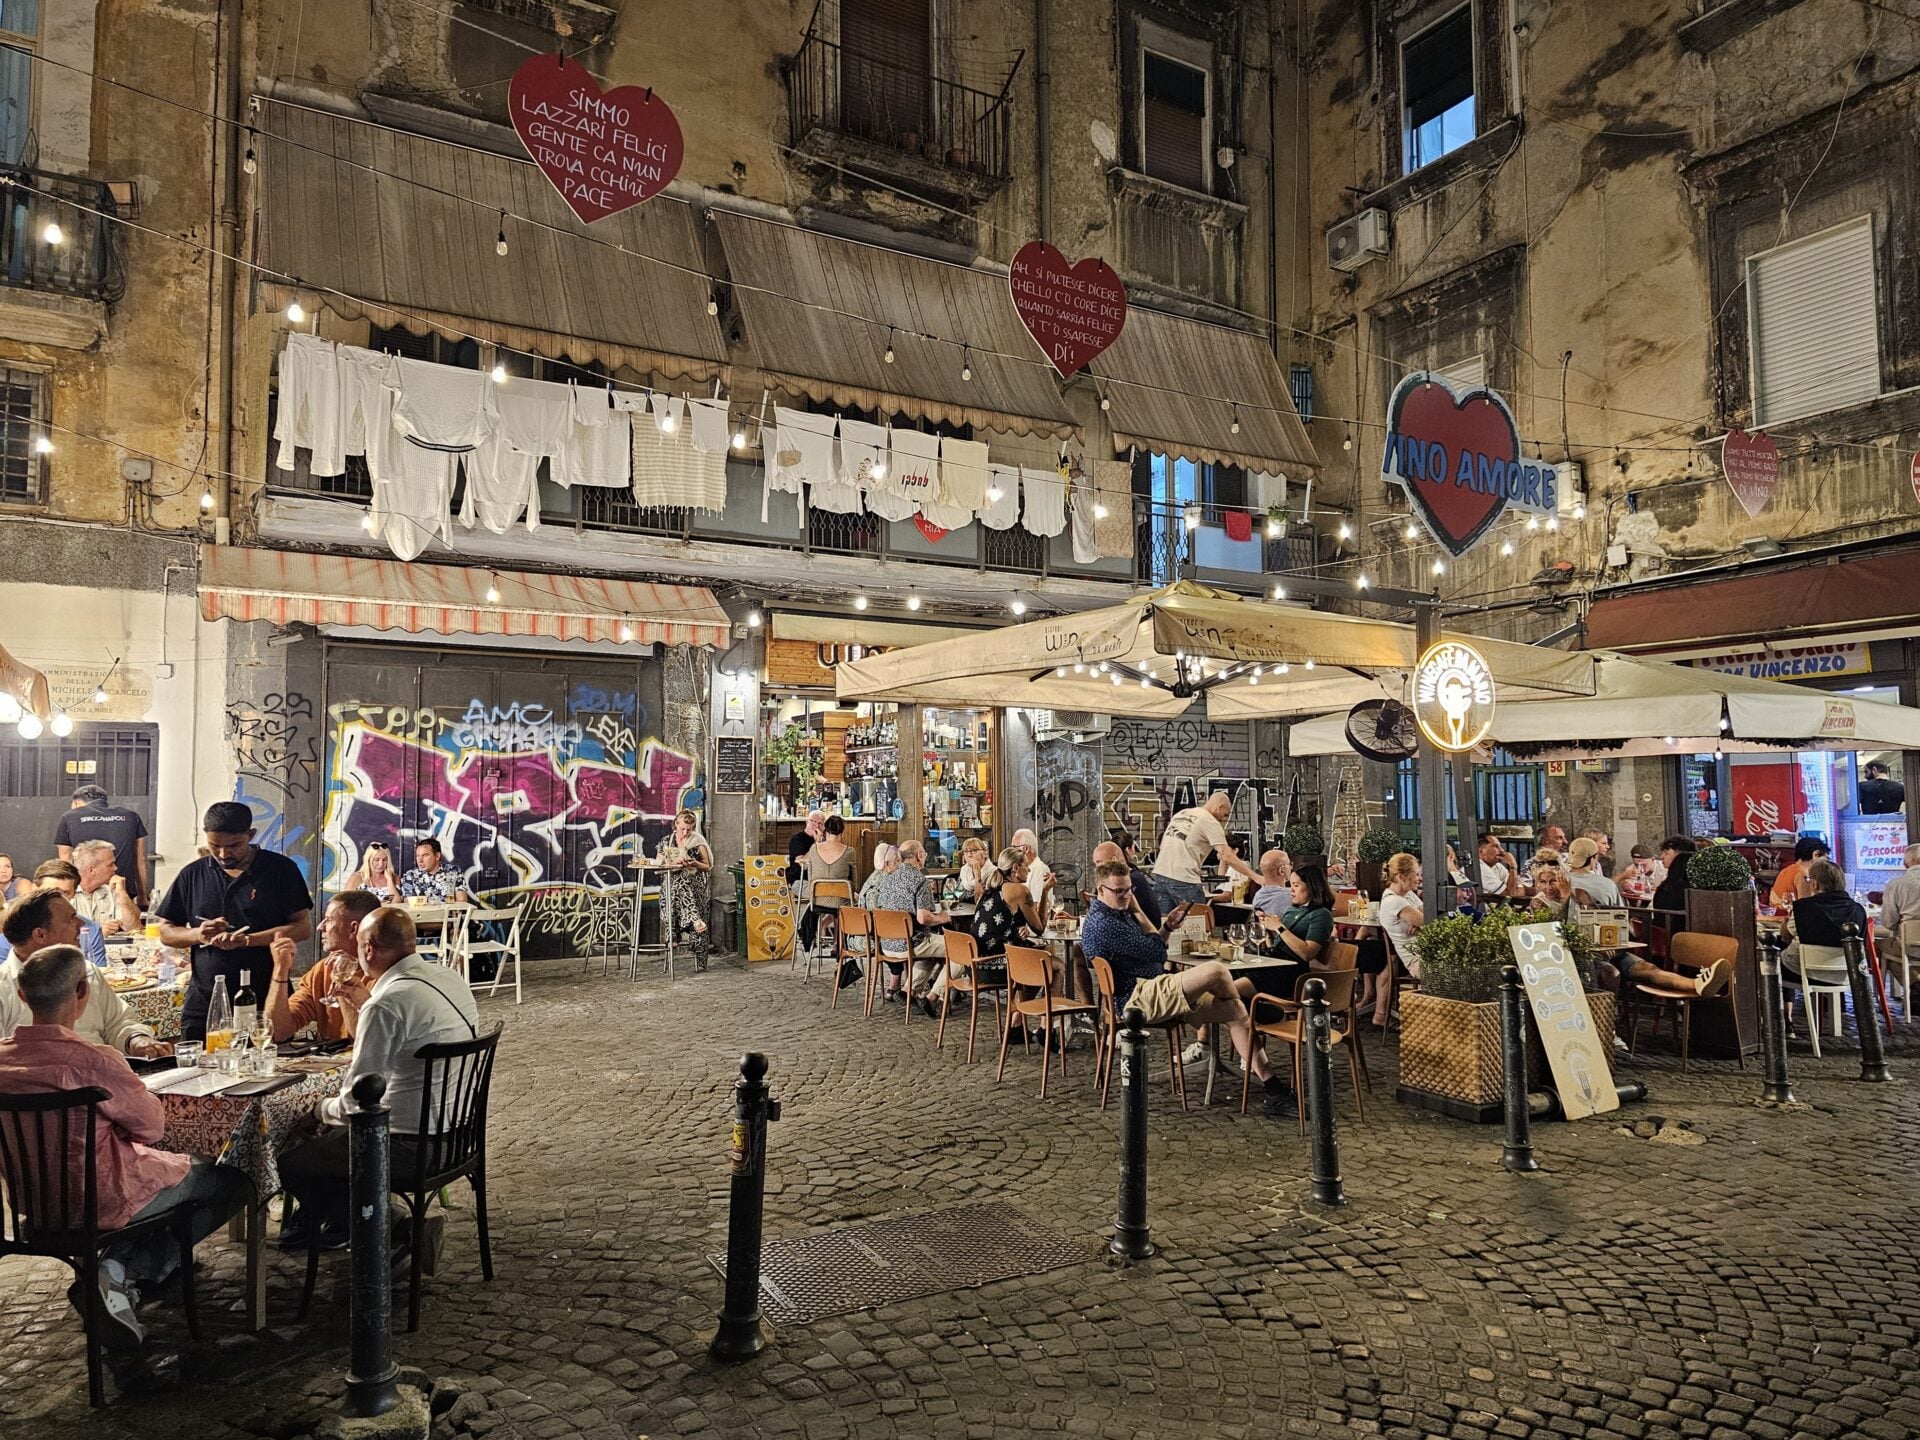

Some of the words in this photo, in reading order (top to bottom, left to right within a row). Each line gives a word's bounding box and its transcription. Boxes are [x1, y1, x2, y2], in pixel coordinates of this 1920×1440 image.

[568, 88, 630, 127] SIMMO
[522, 93, 606, 140] LAZZARI
[613, 128, 667, 162] FELICI
[528, 122, 589, 155] GENTE
[593, 145, 616, 165] CA
[623, 156, 661, 182] NUN
[533, 144, 584, 176] TROVA
[563, 177, 614, 210] PACE
[1012, 278, 1052, 299] CHELLO
[1074, 296, 1098, 313] CORE
[1101, 303, 1121, 320] DICE
[1088, 283, 1119, 302] DICERE
[1087, 317, 1115, 334] FELICE
[1455, 448, 1556, 510] AMORE
[1750, 483, 1768, 498] VINO
[924, 523, 941, 534] MIA
[1749, 655, 1846, 679] VINCENZO
[1550, 761, 1563, 773] 58
